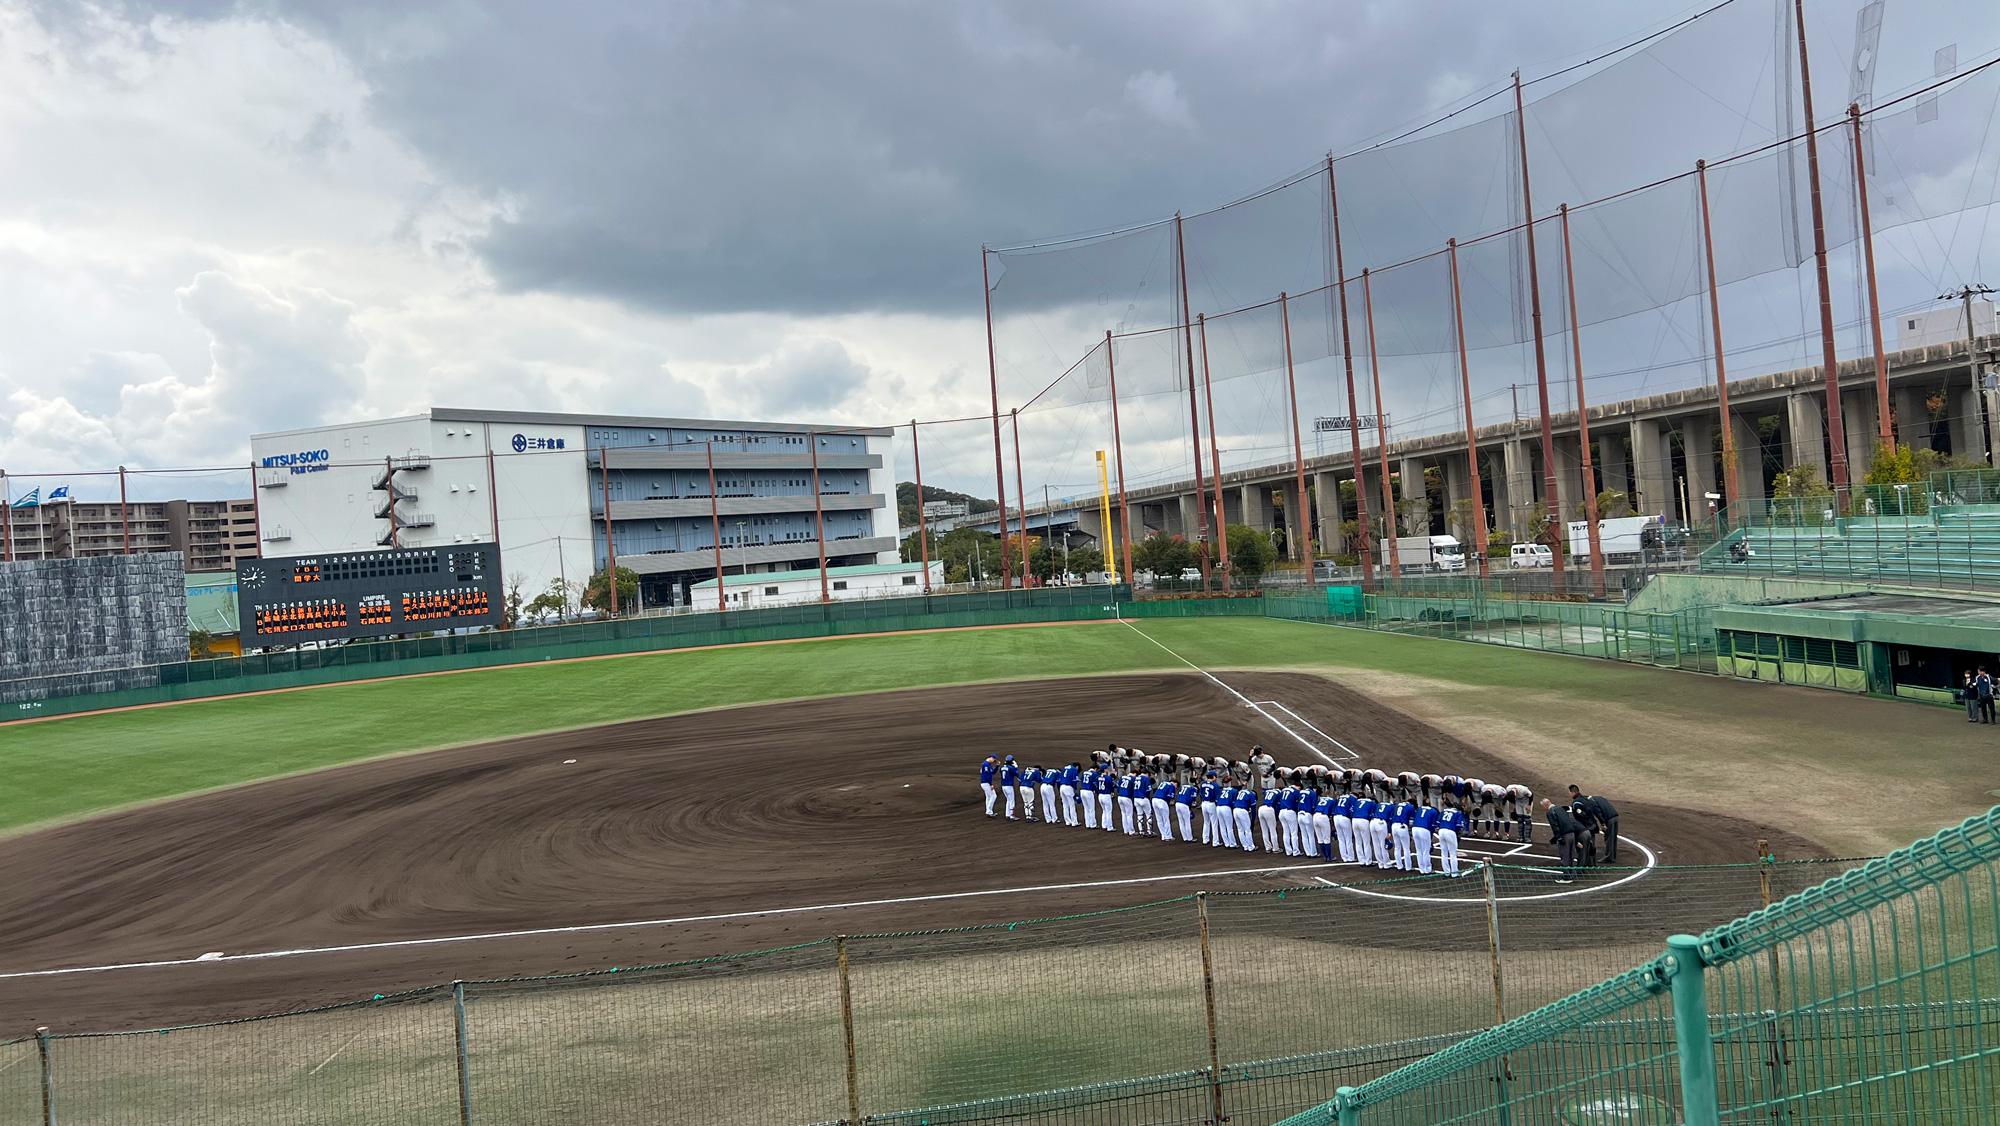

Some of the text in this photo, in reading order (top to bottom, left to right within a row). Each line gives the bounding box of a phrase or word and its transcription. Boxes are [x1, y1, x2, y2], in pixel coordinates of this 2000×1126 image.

[528, 438, 565, 450] 三井倉庫
[262, 449, 329, 468] MITSUI-SOKO
[1083, 774, 1090, 783] 15
[1098, 781, 1105, 790] 16
[1205, 788, 1209, 797] 5
[1300, 794, 1305, 803] 2
[1338, 798, 1346, 806] 12
[1396, 807, 1402, 816] 8
[1442, 812, 1453, 821] 28
